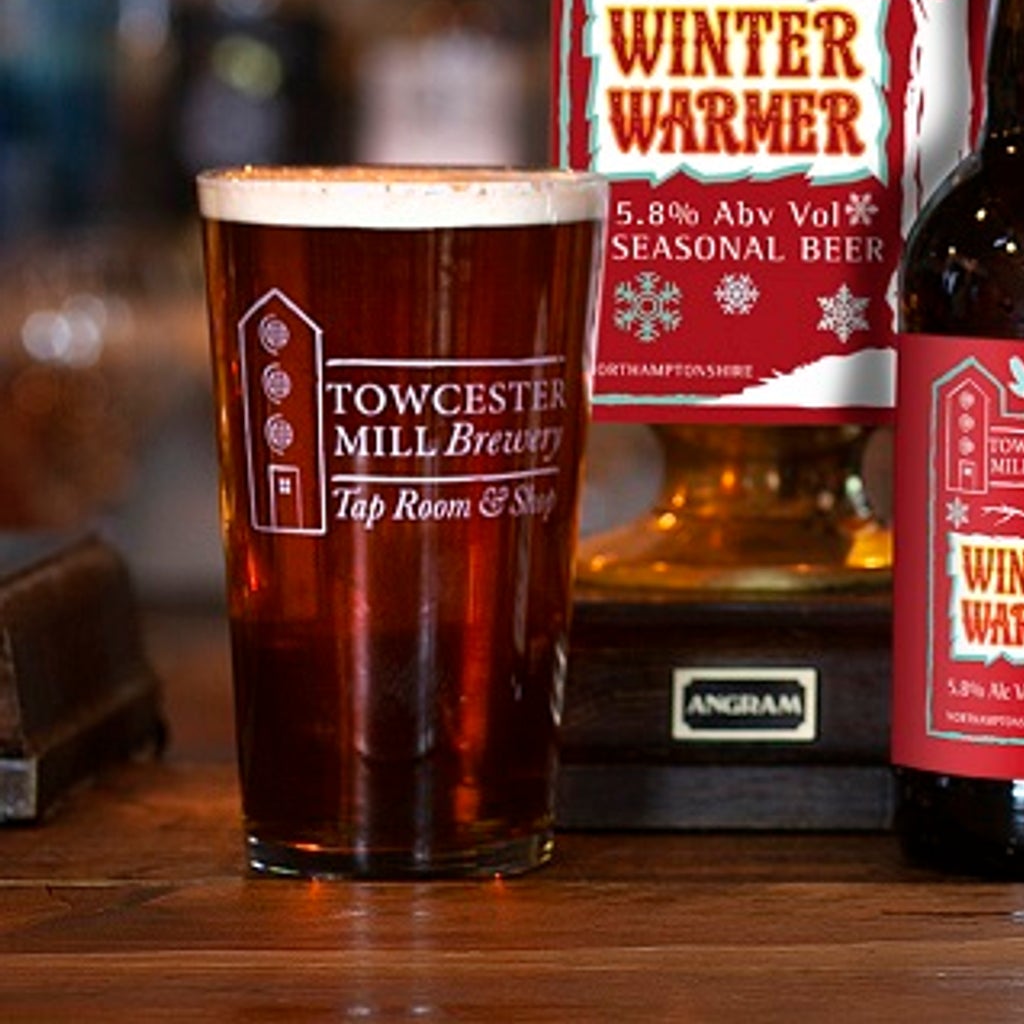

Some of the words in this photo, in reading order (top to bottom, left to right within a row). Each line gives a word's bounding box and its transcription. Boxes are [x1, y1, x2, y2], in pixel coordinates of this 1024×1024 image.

[606, 6, 865, 82] WINTER
[606, 88, 867, 156] WARMER
[614, 200, 700, 226] 5.8%
[713, 200, 775, 226] Abv
[786, 200, 840, 227] Vol
[611, 233, 786, 261] SEASONAL
[800, 235, 885, 263] BEER
[597, 362, 753, 378] ORTHAMPTONSHIRE
[325, 378, 567, 416] TOWCESTER
[333, 424, 438, 457] MILL
[443, 421, 564, 463] Brewery
[332, 486, 386, 531] Tap
[392, 487, 472, 522] Room
[477, 485, 509, 519] &
[686, 692, 803, 717] ANGRAM
